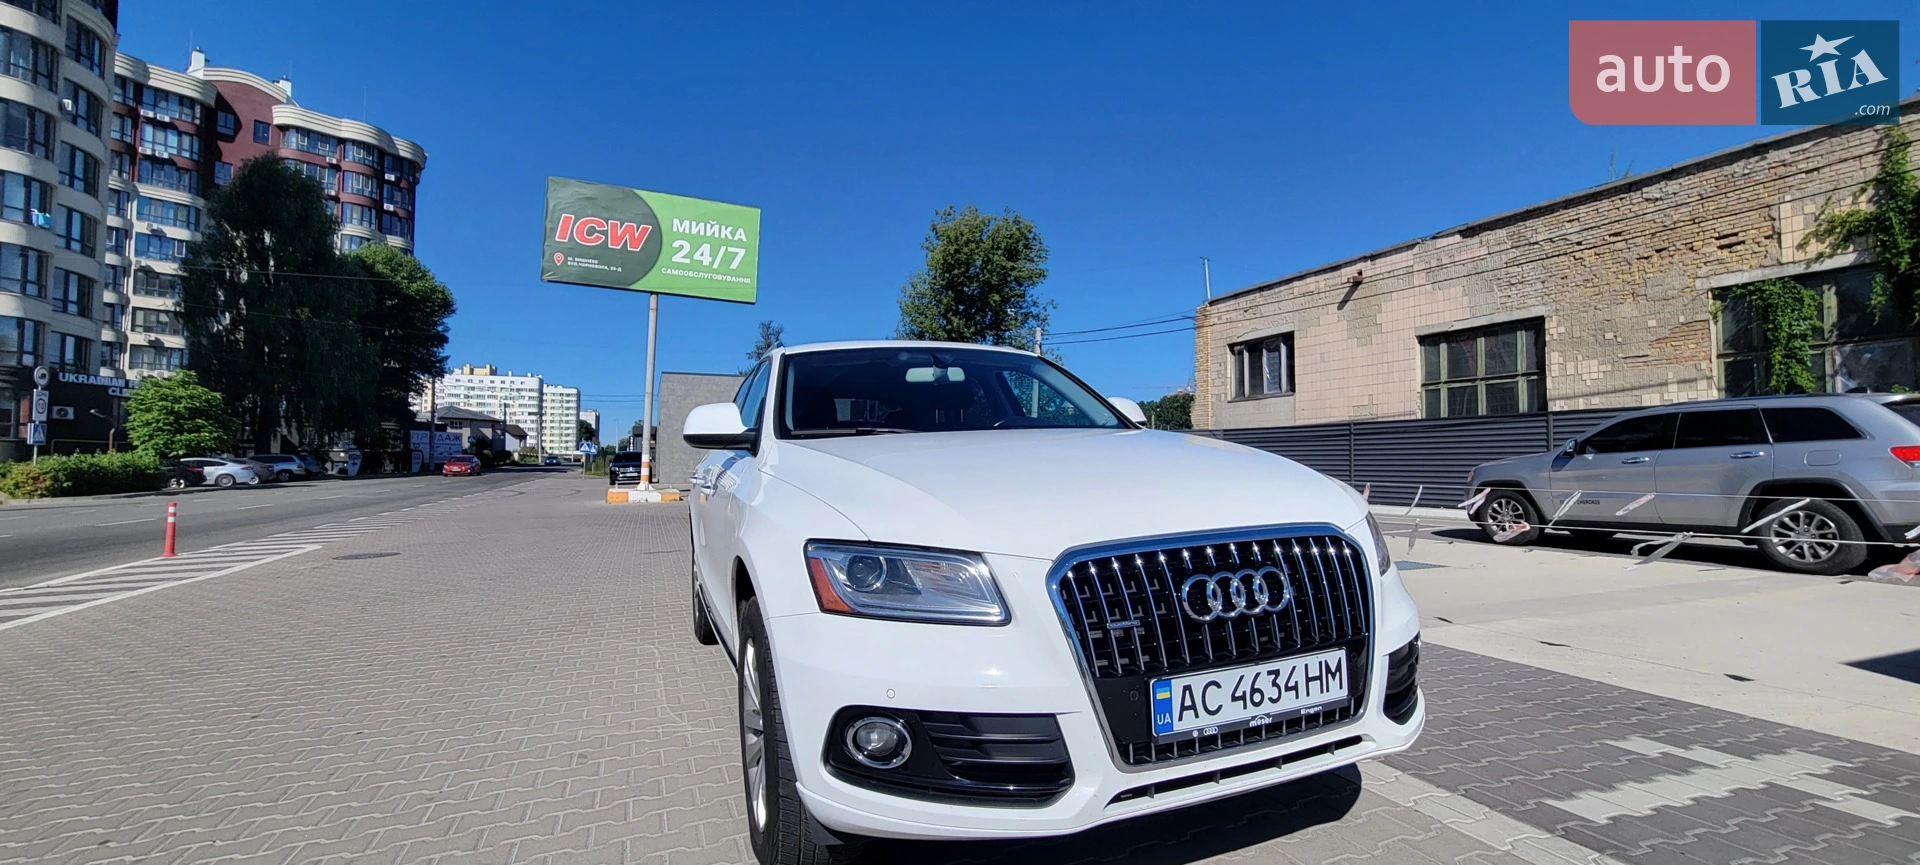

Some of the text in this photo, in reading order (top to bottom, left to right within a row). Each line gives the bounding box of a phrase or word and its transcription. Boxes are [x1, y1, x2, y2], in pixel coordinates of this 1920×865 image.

[555, 213, 652, 251] ICW
[672, 217, 747, 242] МИЙКА
[671, 239, 746, 270] 24/7
[661, 266, 751, 284] САМООБСЛУГОВУВАННЯ
[59, 372, 126, 386] UKRAINIAN
[1177, 656, 1344, 722] AC 4634 HM
[1157, 713, 1172, 727] UA
[1300, 705, 1323, 715] Engen
